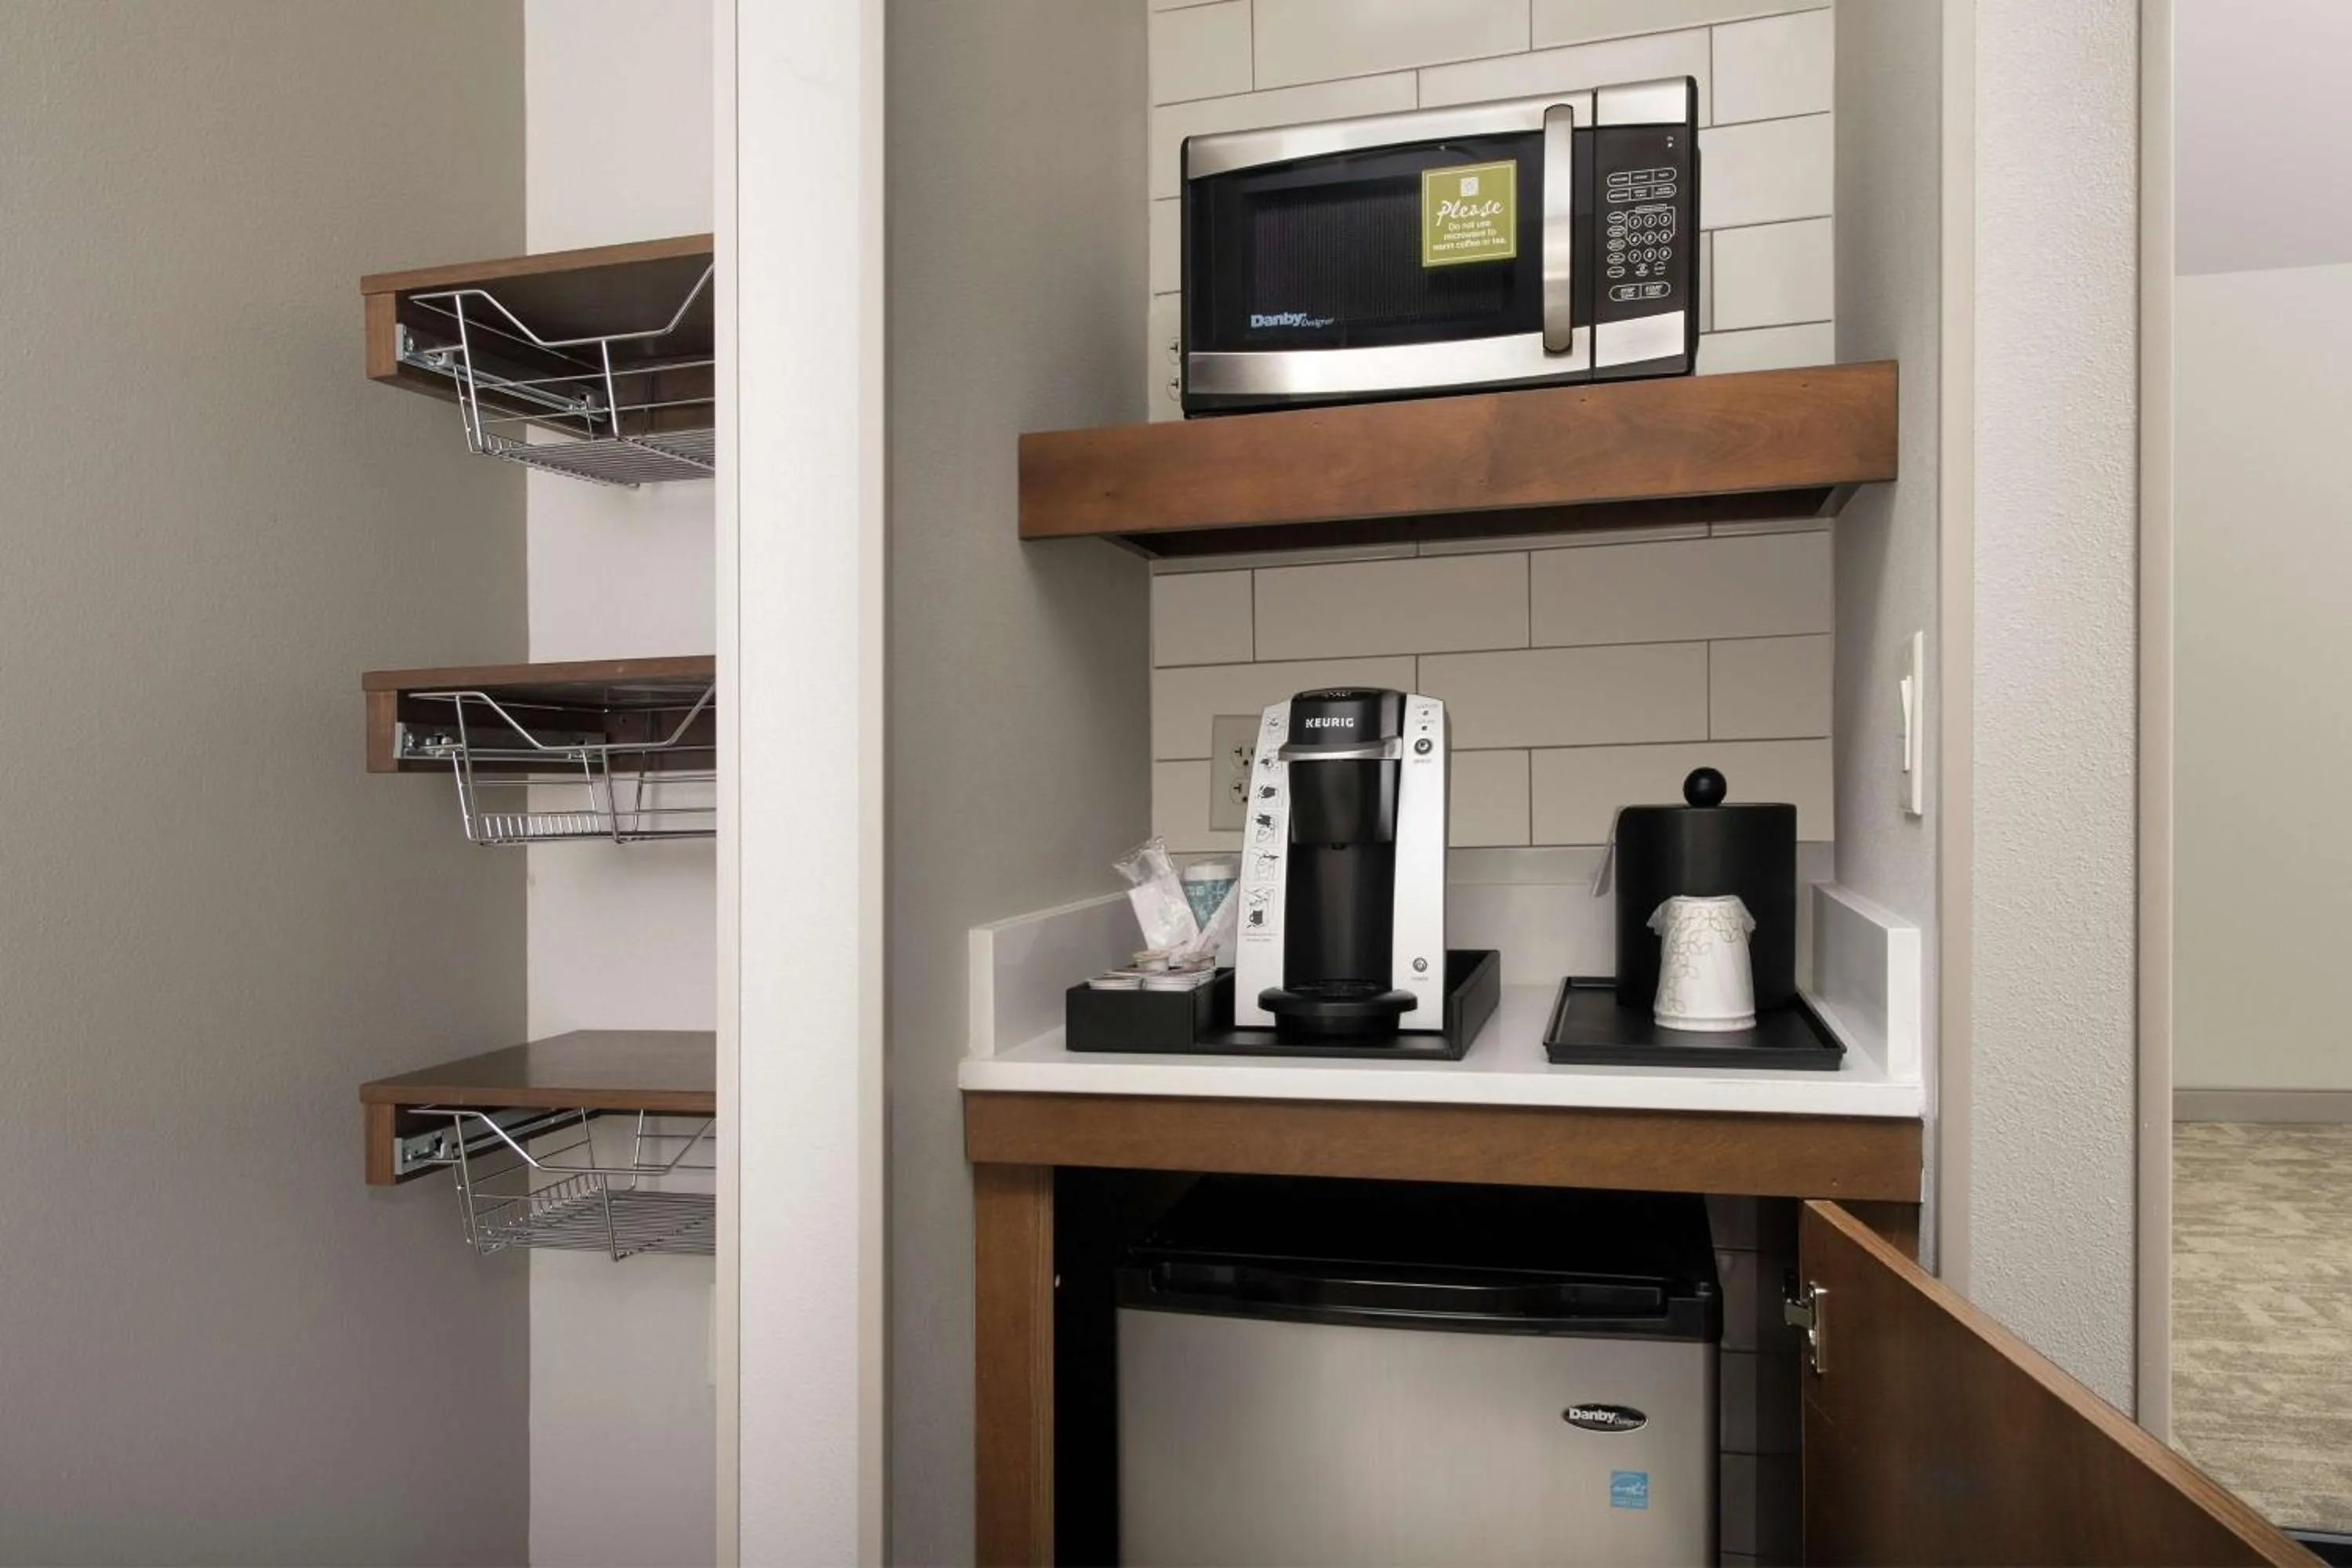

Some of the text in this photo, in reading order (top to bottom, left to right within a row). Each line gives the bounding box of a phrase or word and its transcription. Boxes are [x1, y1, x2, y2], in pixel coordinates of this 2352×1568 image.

[1436, 200, 1504, 227] Please
[1448, 223, 1461, 231] Do
[1461, 221, 1475, 230] not
[1250, 312, 1303, 328] Danby
[1305, 717, 1355, 728] KEURIG
[1569, 1408, 1616, 1424] Danby
